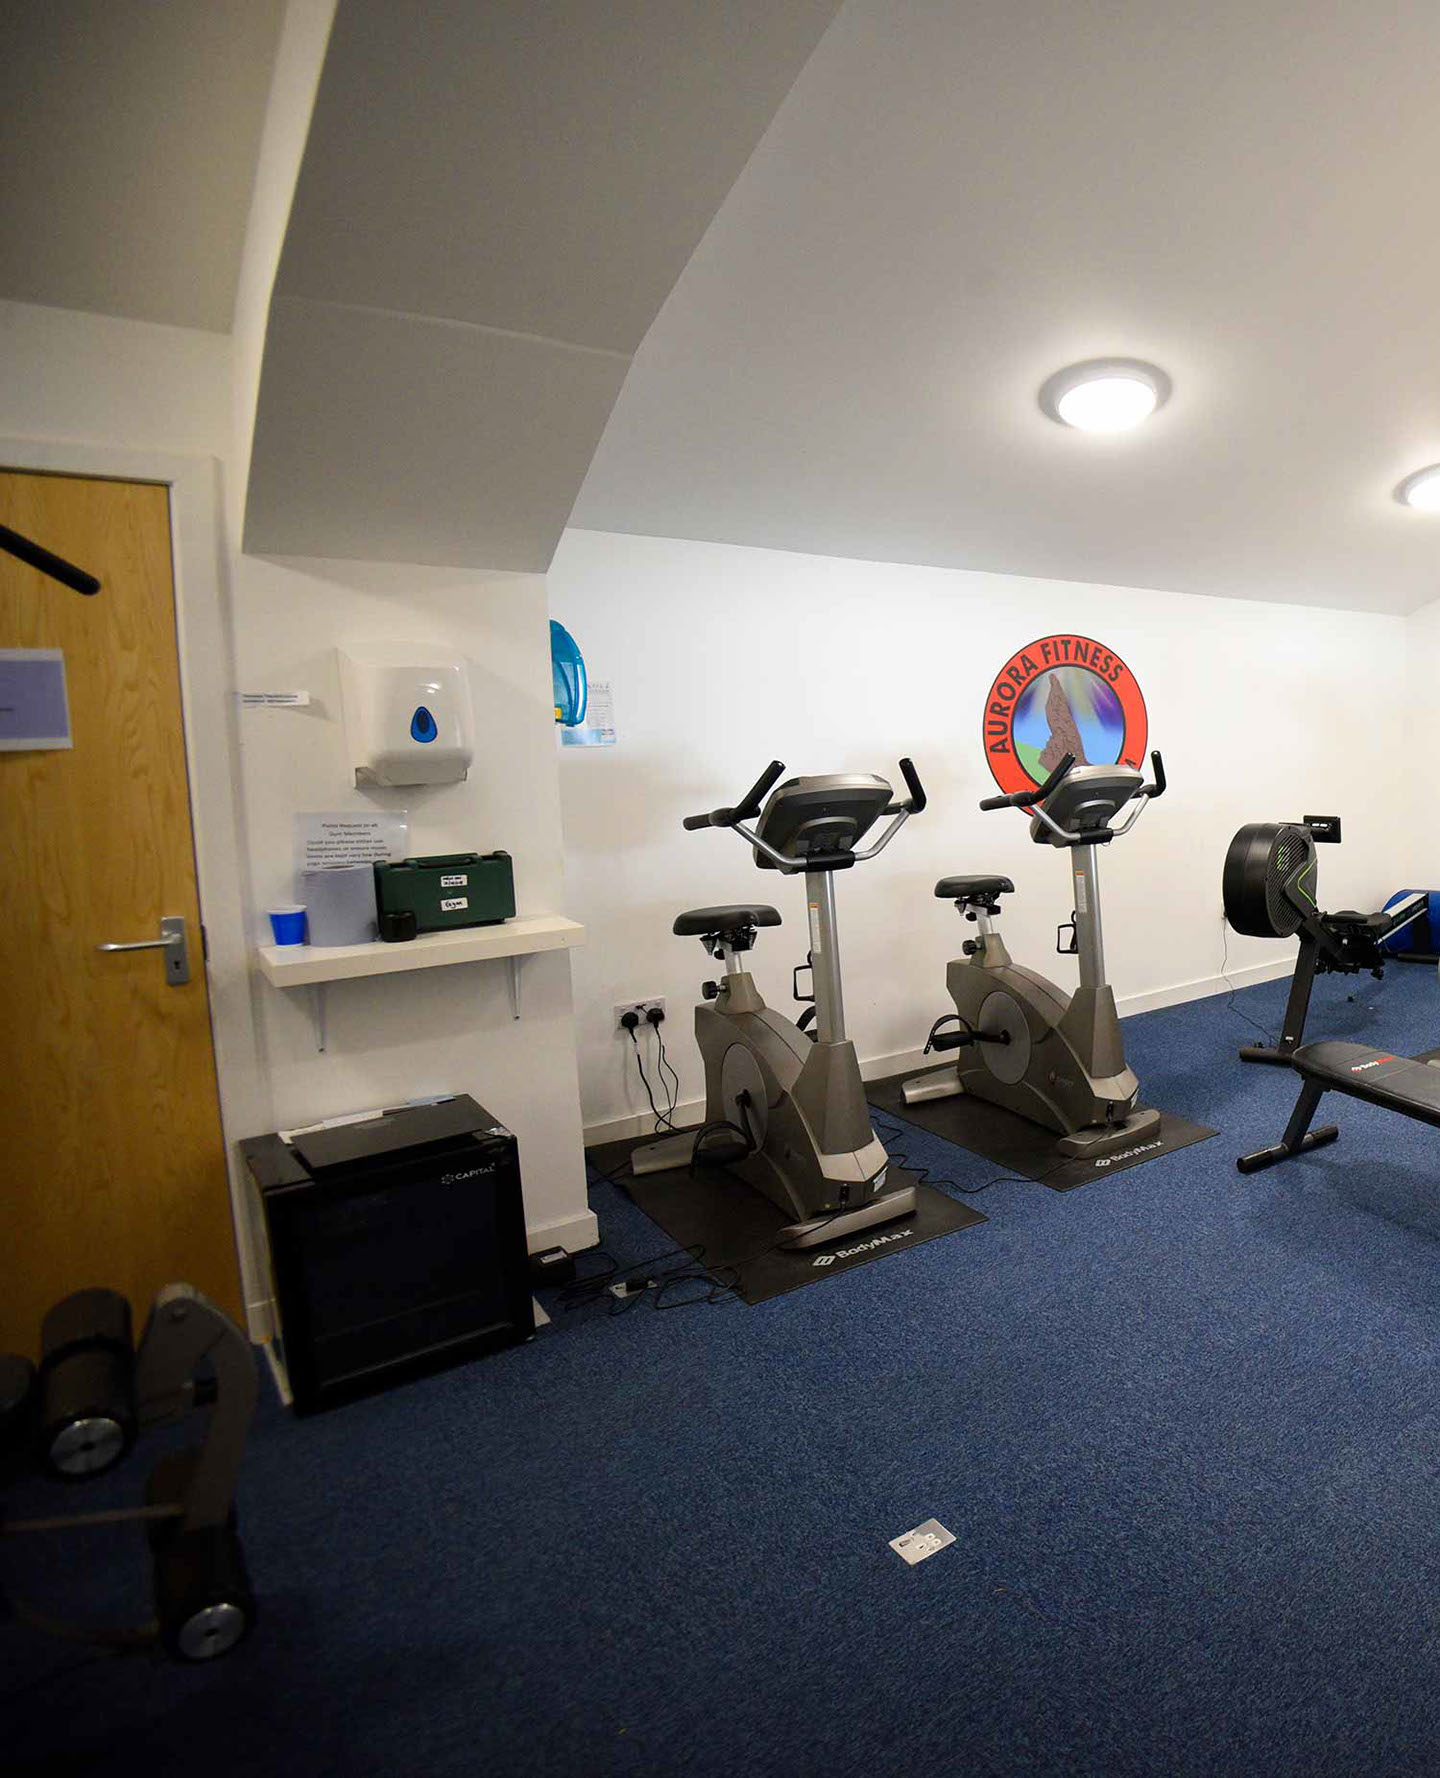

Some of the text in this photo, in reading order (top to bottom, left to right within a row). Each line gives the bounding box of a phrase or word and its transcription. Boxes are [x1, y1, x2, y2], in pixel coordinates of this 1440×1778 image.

[987, 640, 1124, 754] AURORA FITNESS
[455, 1166, 495, 1180] CAPITAL
[835, 1229, 914, 1259] BodyMax
